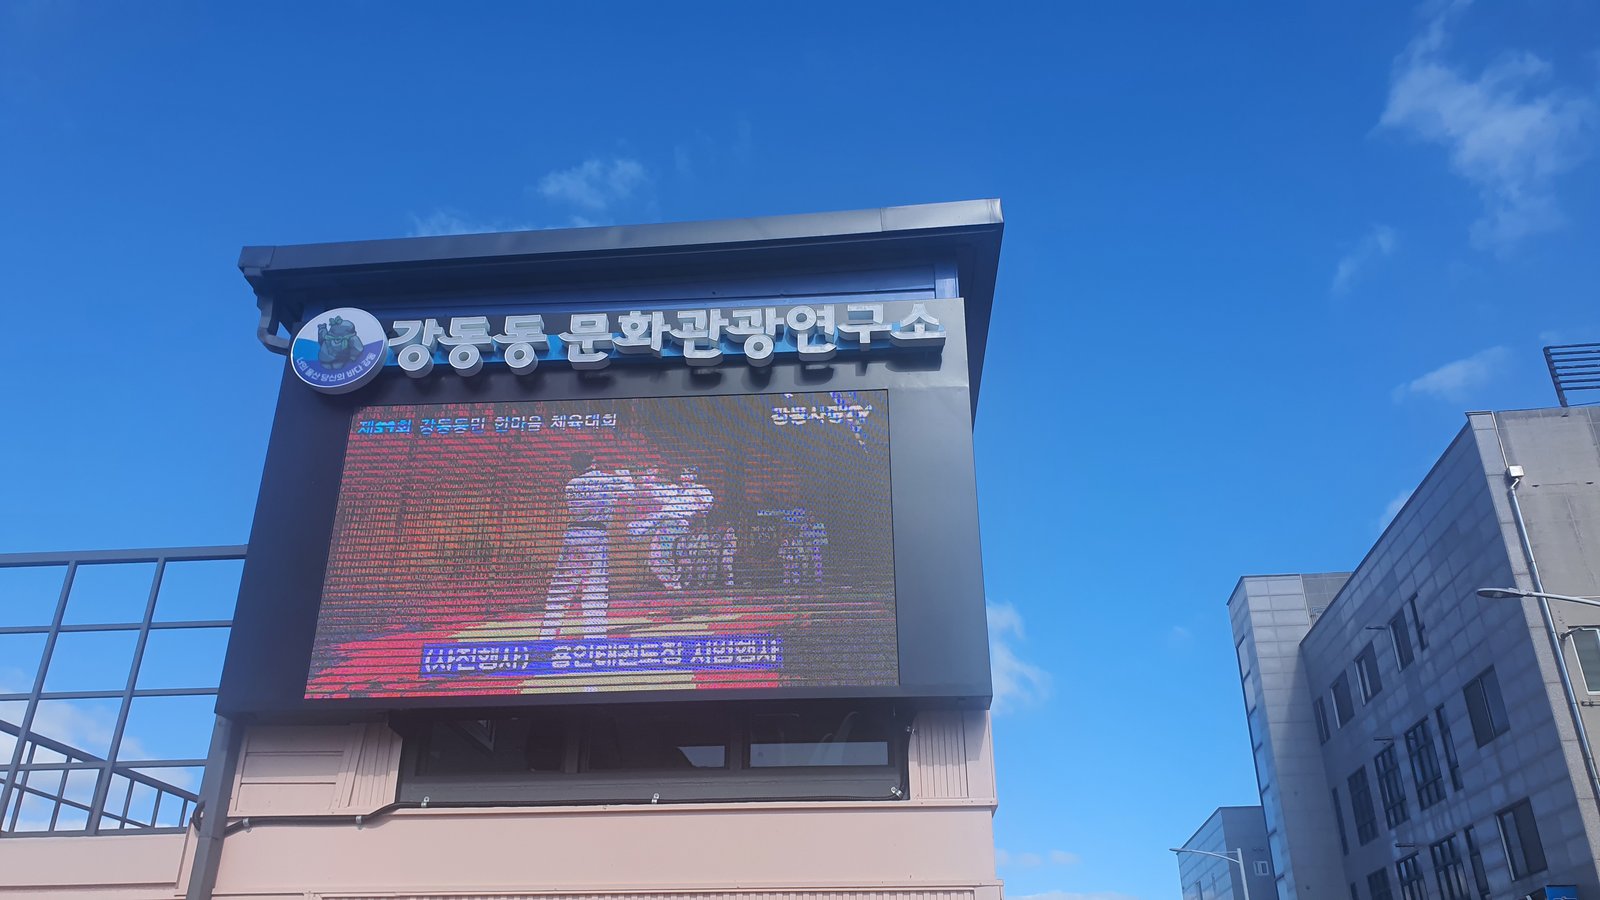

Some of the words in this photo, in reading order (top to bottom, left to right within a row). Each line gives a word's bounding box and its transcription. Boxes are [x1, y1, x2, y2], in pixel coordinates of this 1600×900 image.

[387, 314, 550, 377] 강동동
[558, 303, 947, 370] 문화관광연구소
[346, 365, 363, 378] 바다
[419, 416, 485, 434] 강동동민
[494, 415, 545, 432] 한마음
[550, 413, 617, 430] 체육대회
